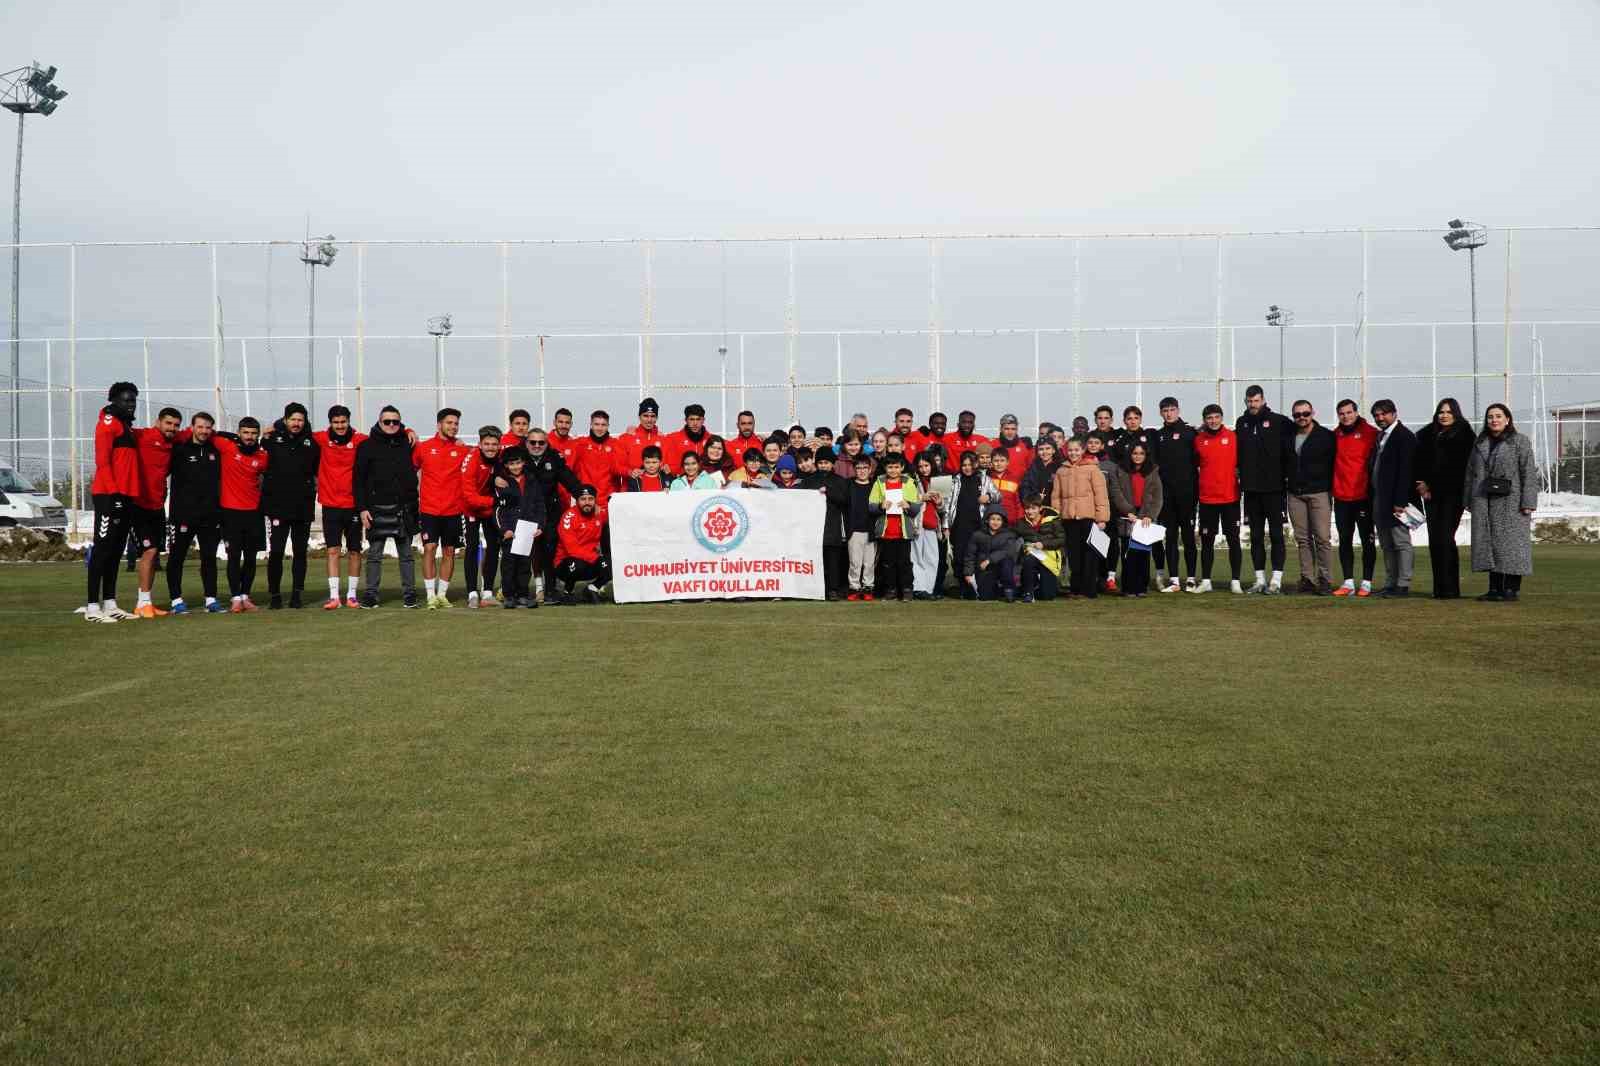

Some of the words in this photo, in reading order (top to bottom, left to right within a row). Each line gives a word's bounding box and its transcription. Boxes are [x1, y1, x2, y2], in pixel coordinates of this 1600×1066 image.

[623, 559, 718, 578] CUMHURİYET
[720, 557, 815, 576] ÜNİVERSİTESİ
[663, 579, 706, 594] VAKFI
[708, 578, 780, 593] OKULLARI
